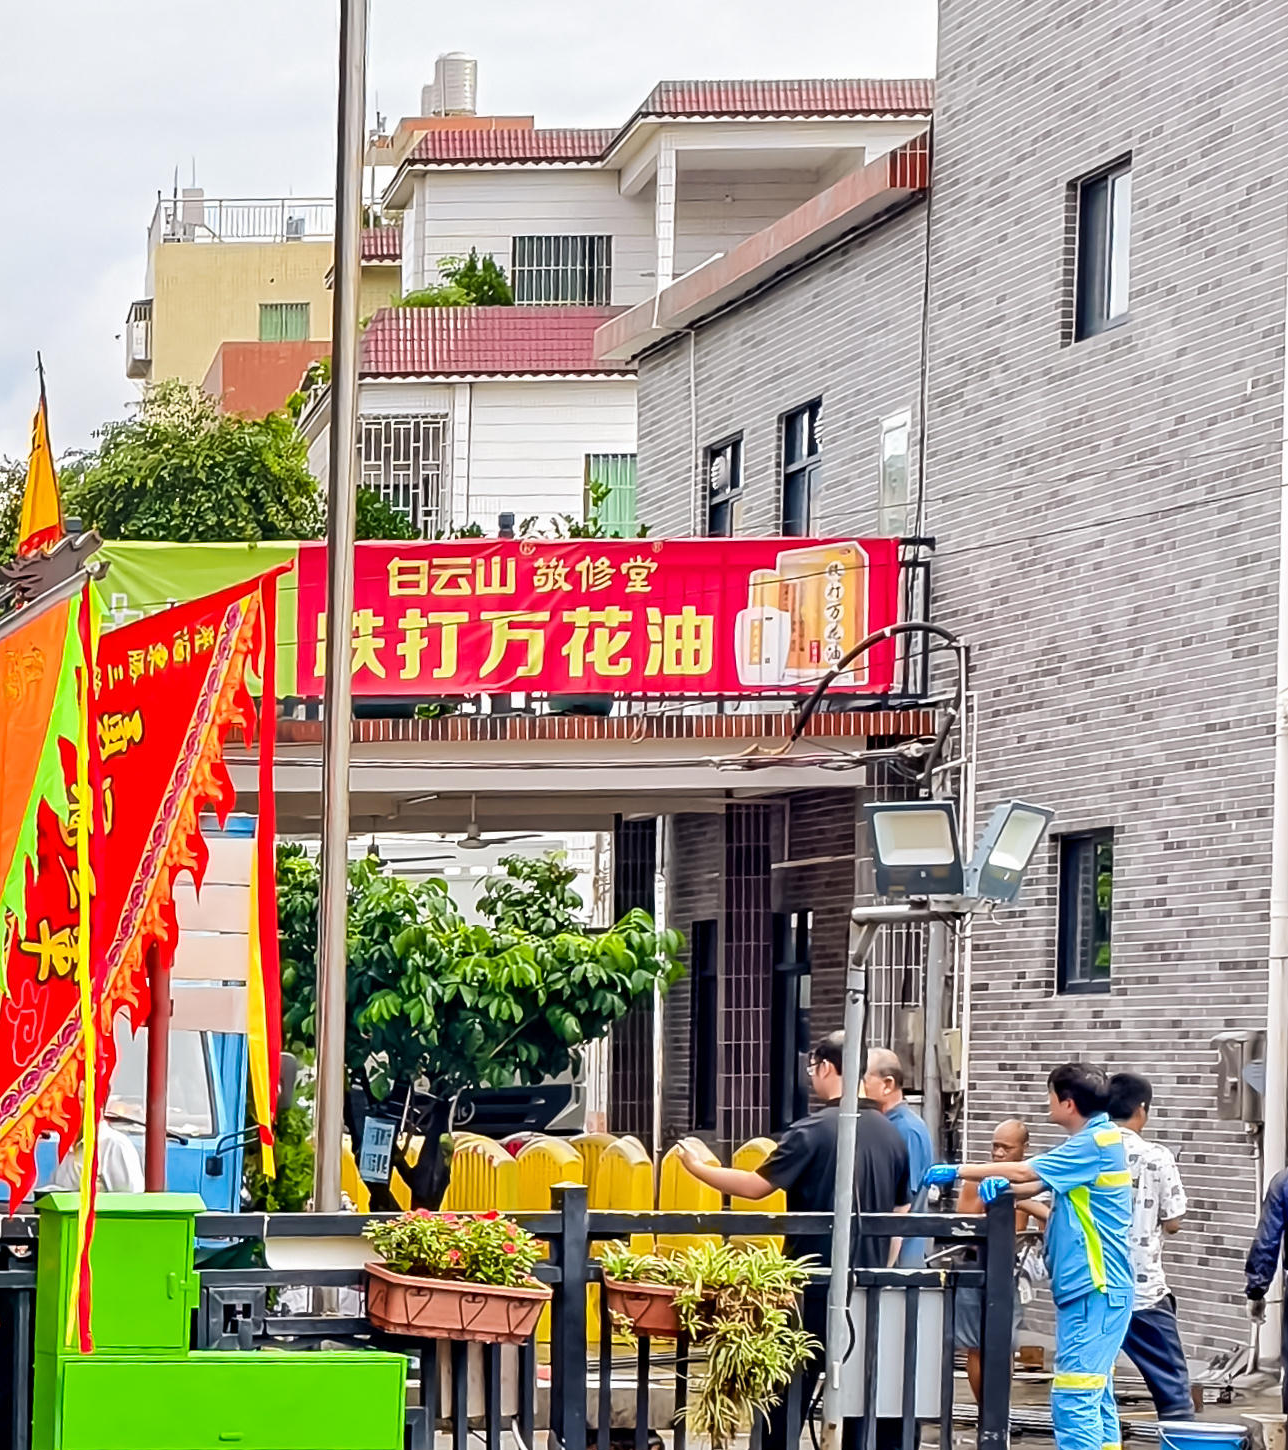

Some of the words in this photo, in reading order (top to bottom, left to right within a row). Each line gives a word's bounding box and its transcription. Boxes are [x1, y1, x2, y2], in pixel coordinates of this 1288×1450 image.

[387, 556, 516, 596] 白云山
[533, 554, 659, 594] 敬修堂
